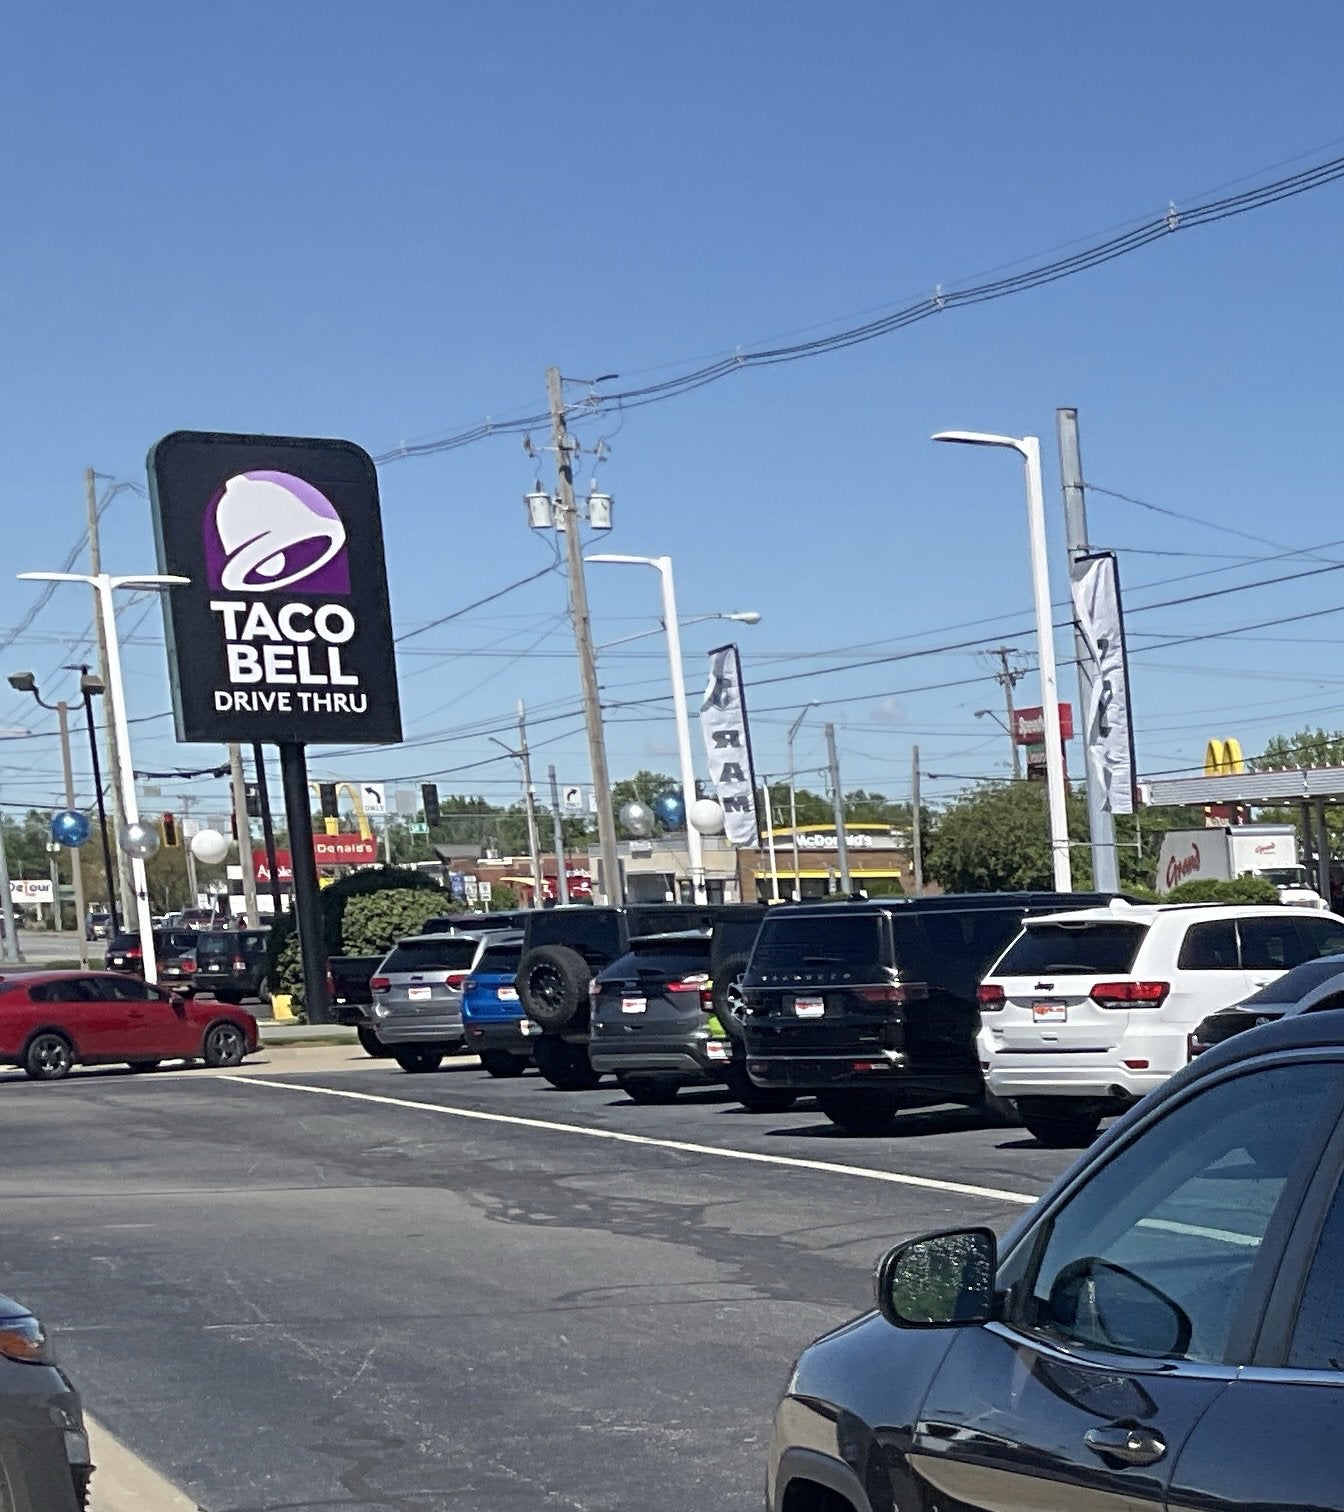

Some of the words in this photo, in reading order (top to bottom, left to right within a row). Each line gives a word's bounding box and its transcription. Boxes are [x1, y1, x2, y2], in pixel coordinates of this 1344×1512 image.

[210, 601, 355, 643] TACO
[227, 644, 359, 685] BELL
[214, 691, 292, 712] DRIVE
[297, 692, 367, 713] THRU
[315, 843, 373, 854] Donald's
